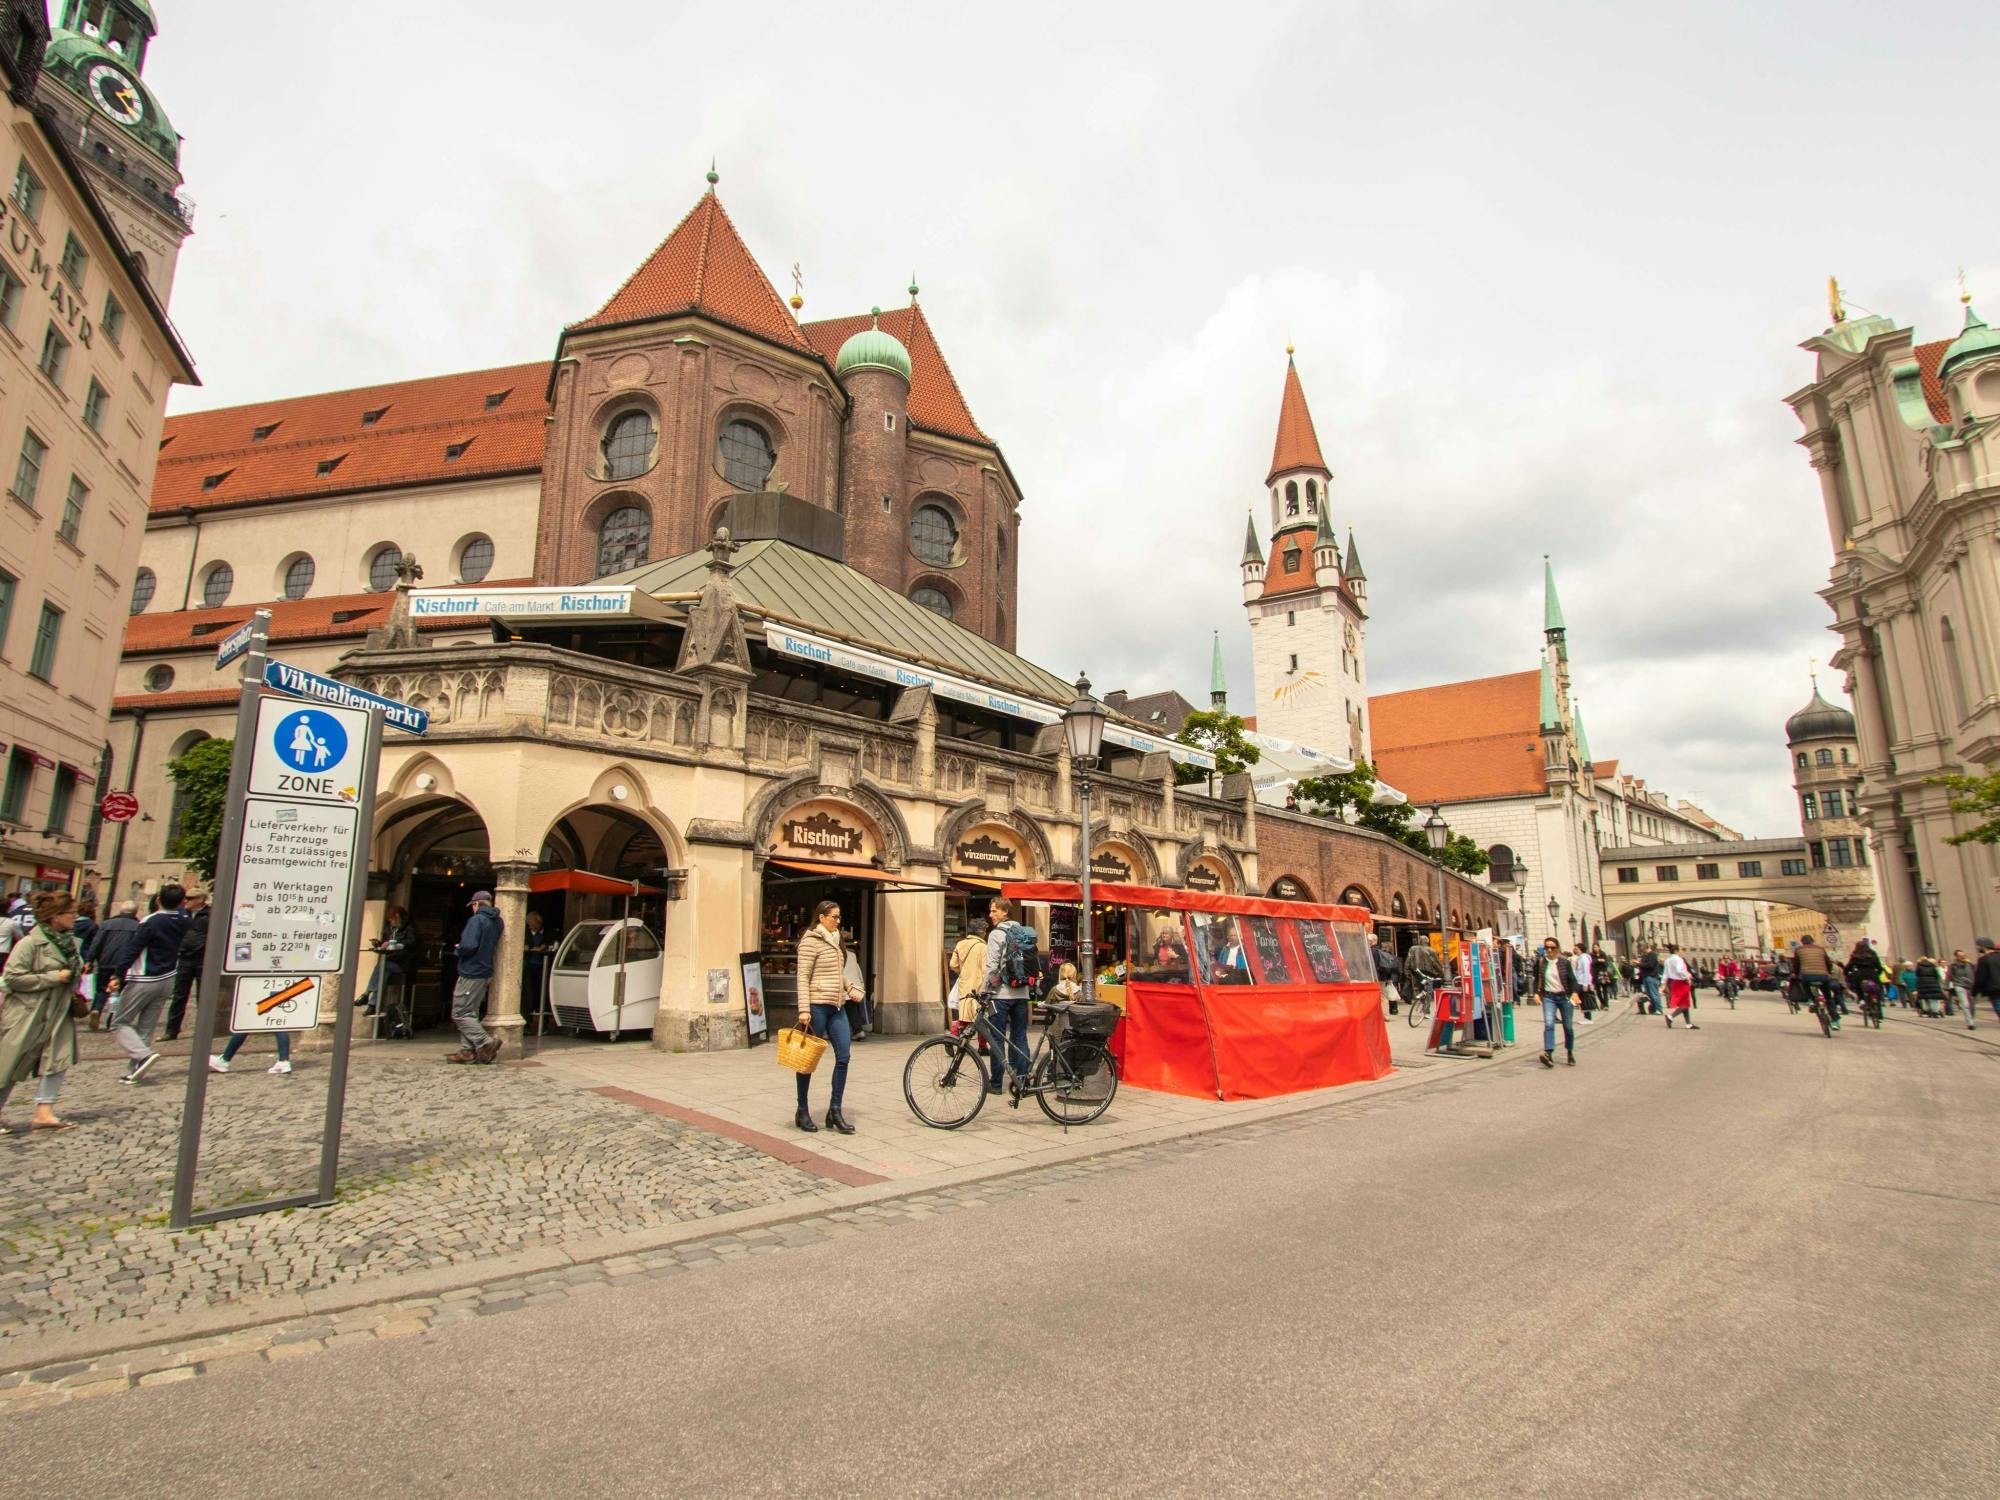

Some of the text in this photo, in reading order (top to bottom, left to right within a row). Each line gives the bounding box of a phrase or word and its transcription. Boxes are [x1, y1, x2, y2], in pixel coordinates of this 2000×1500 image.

[415, 597, 479, 613] Rischart
[508, 603, 525, 612] am
[527, 600, 554, 612] Markt
[560, 594, 625, 611] Rischart
[784, 636, 832, 662] Rischart
[988, 695, 1021, 714] Rischart
[277, 774, 334, 794] ZONE
[250, 820, 349, 834] Lieferverkehr für
[269, 833, 328, 846] Fahrzeuge
[793, 825, 851, 849] Rischart
[245, 843, 262, 853] bis
[290, 846, 348, 859] zulässiges
[964, 849, 1009, 862] vinzenzmurr
[243, 855, 348, 869] Gesamtgewicht frei
[252, 881, 333, 893] an Werktagen
[255, 893, 273, 902] bis
[307, 895, 328, 903] und
[267, 905, 280, 914] ab
[235, 931, 246, 939] an
[251, 930, 277, 939] Sonn-
[293, 931, 338, 941] Feiertagen
[262, 942, 276, 951] ab
[265, 1016, 287, 1026] frei
